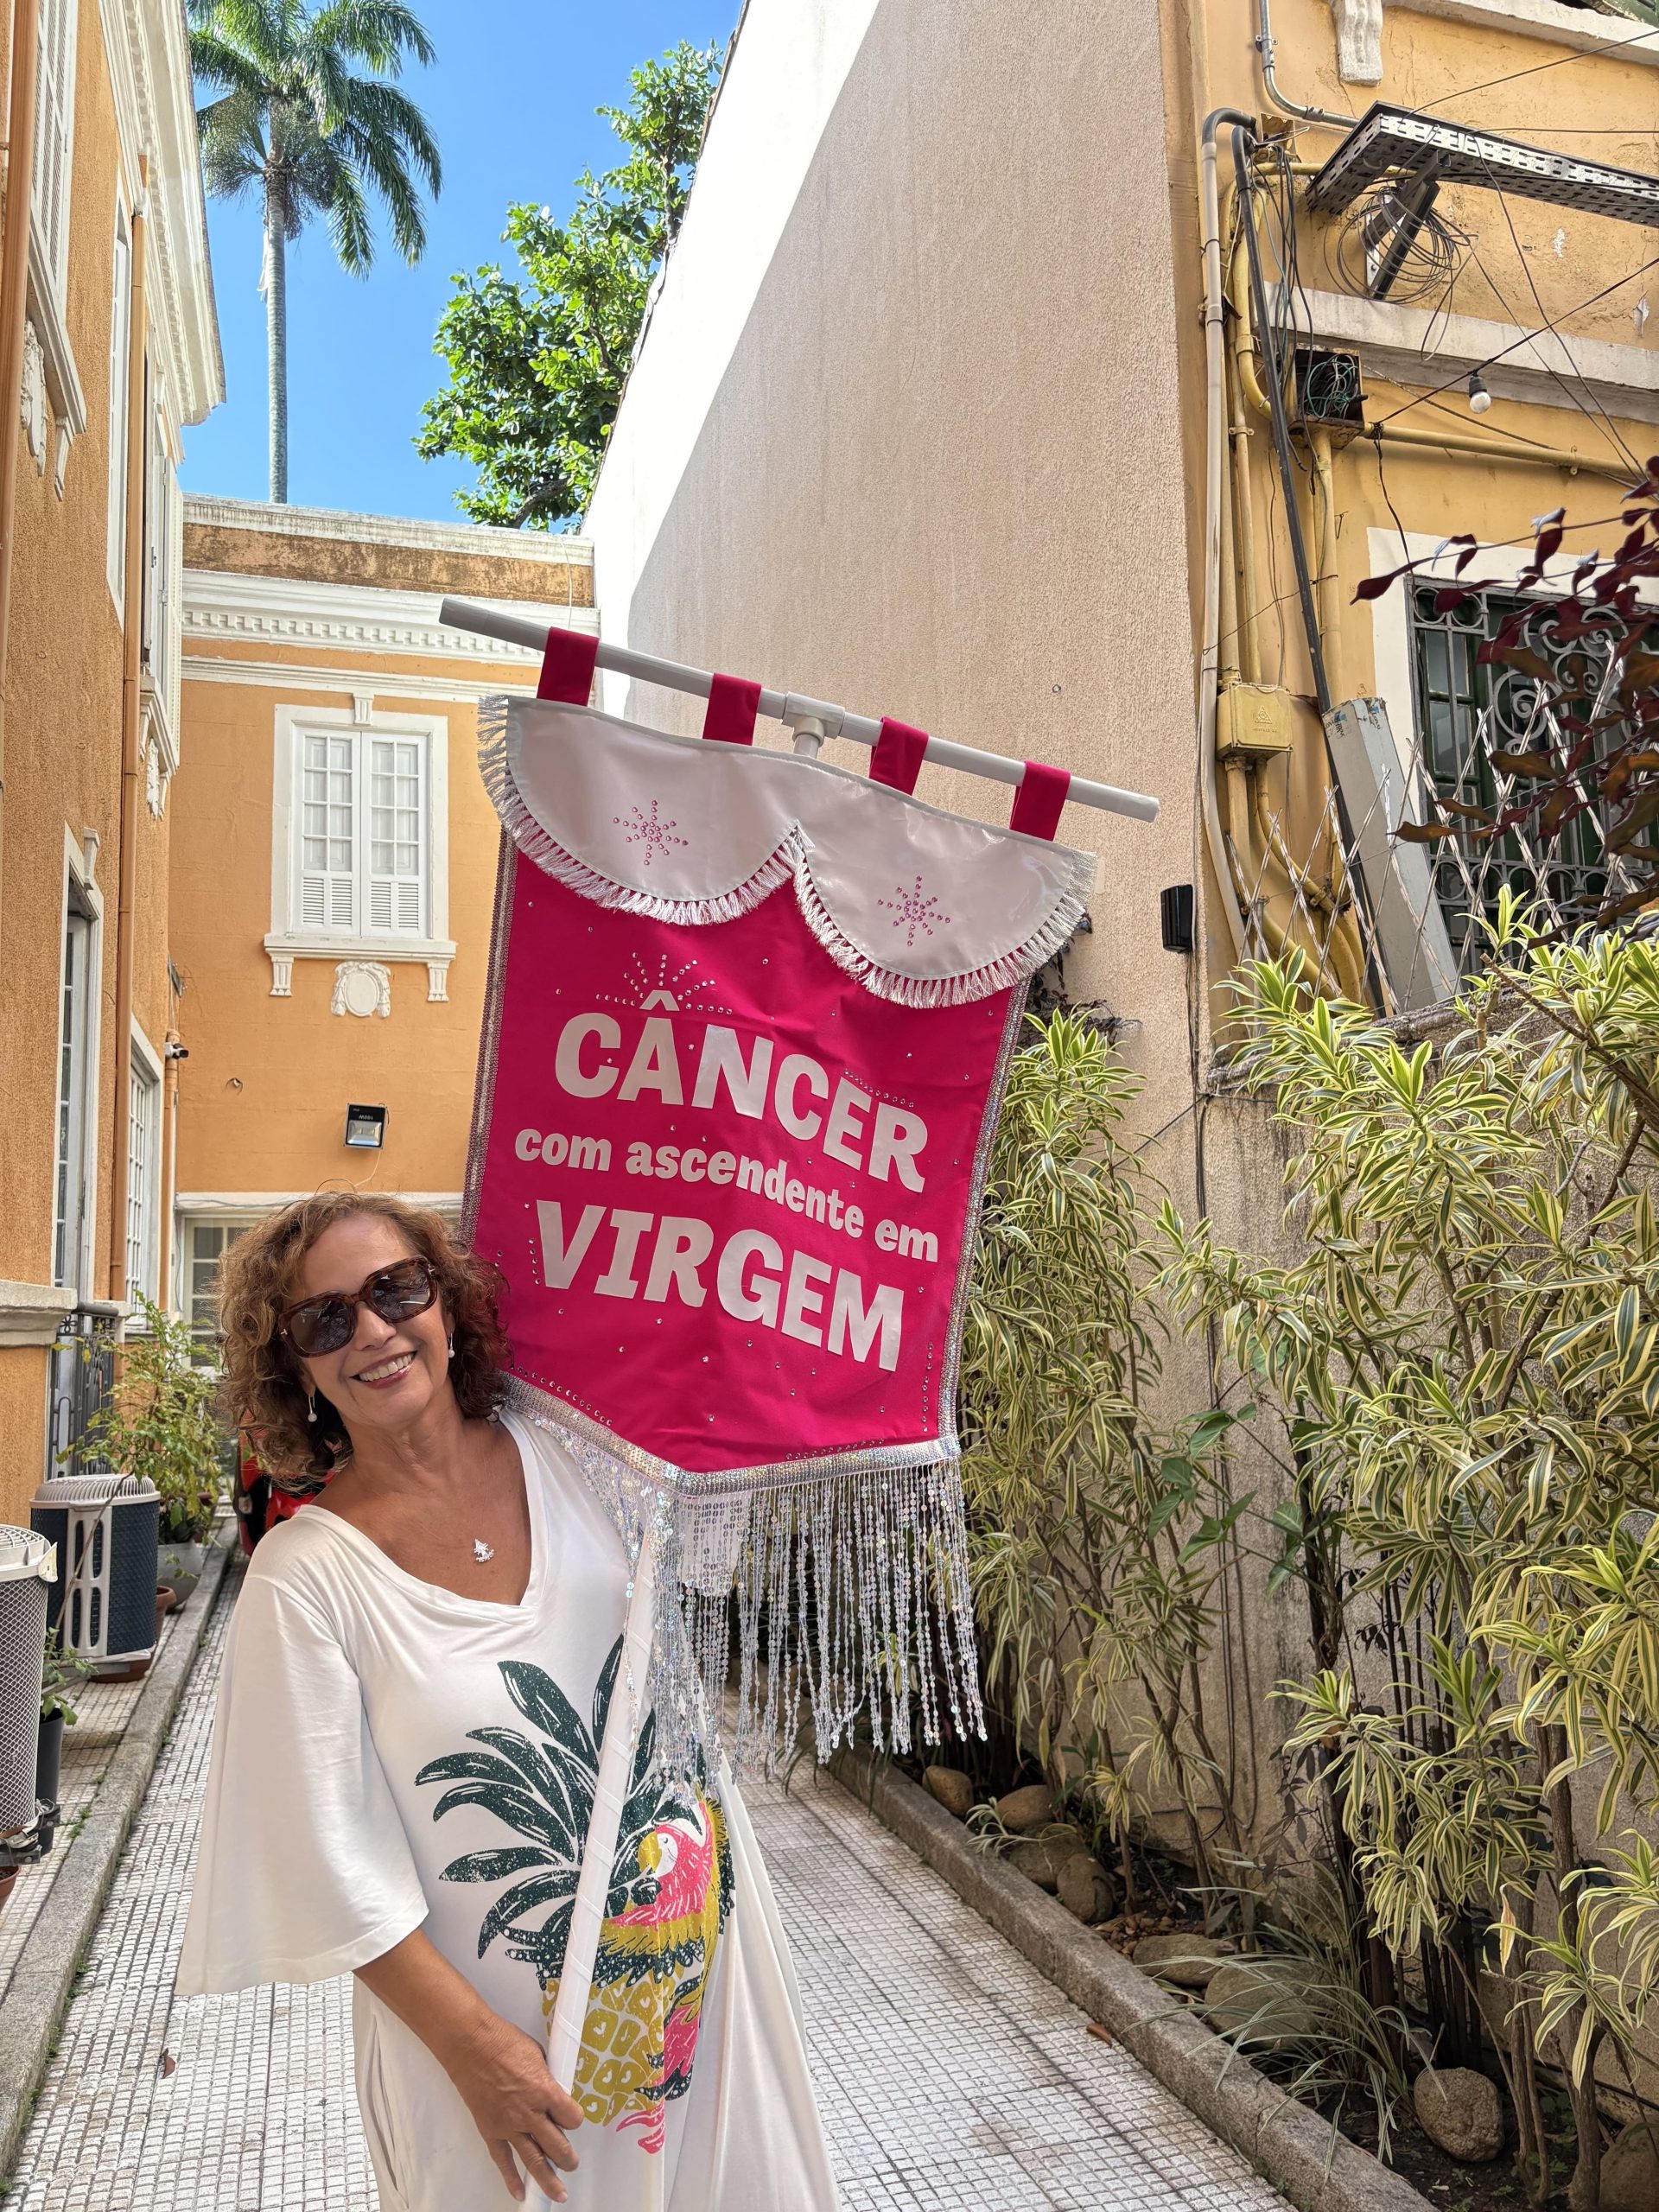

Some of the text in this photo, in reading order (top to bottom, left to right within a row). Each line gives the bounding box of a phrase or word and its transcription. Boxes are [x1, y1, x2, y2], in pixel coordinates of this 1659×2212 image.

[555, 989, 928, 1193] CÂNCER
[515, 1128, 938, 1262] com ascendente em
[536, 1199, 905, 1372] VIRGEM
